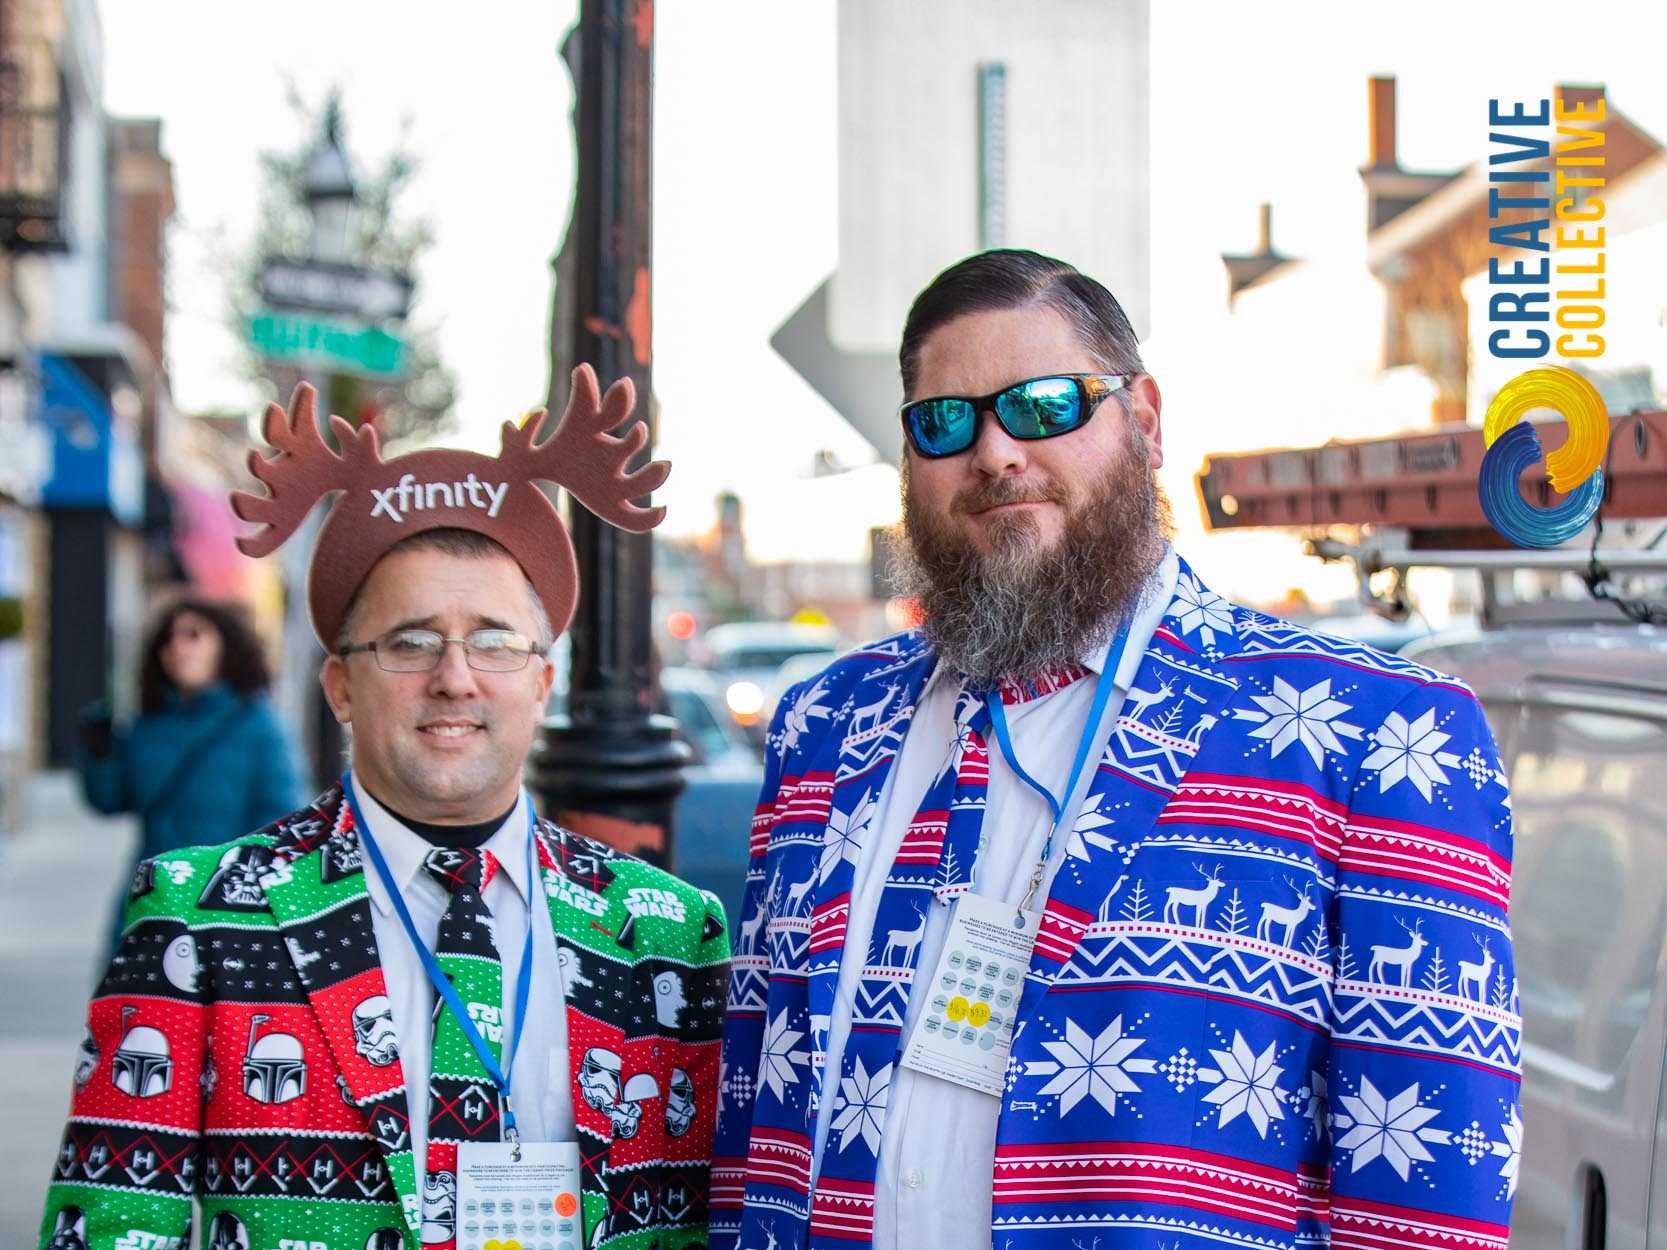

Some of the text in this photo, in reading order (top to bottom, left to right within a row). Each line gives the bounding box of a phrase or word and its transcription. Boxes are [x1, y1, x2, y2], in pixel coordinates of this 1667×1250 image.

[370, 472, 509, 523] xfinity
[544, 882, 608, 918] WARS
[622, 887, 687, 909] STAR
[625, 900, 686, 923] WARS
